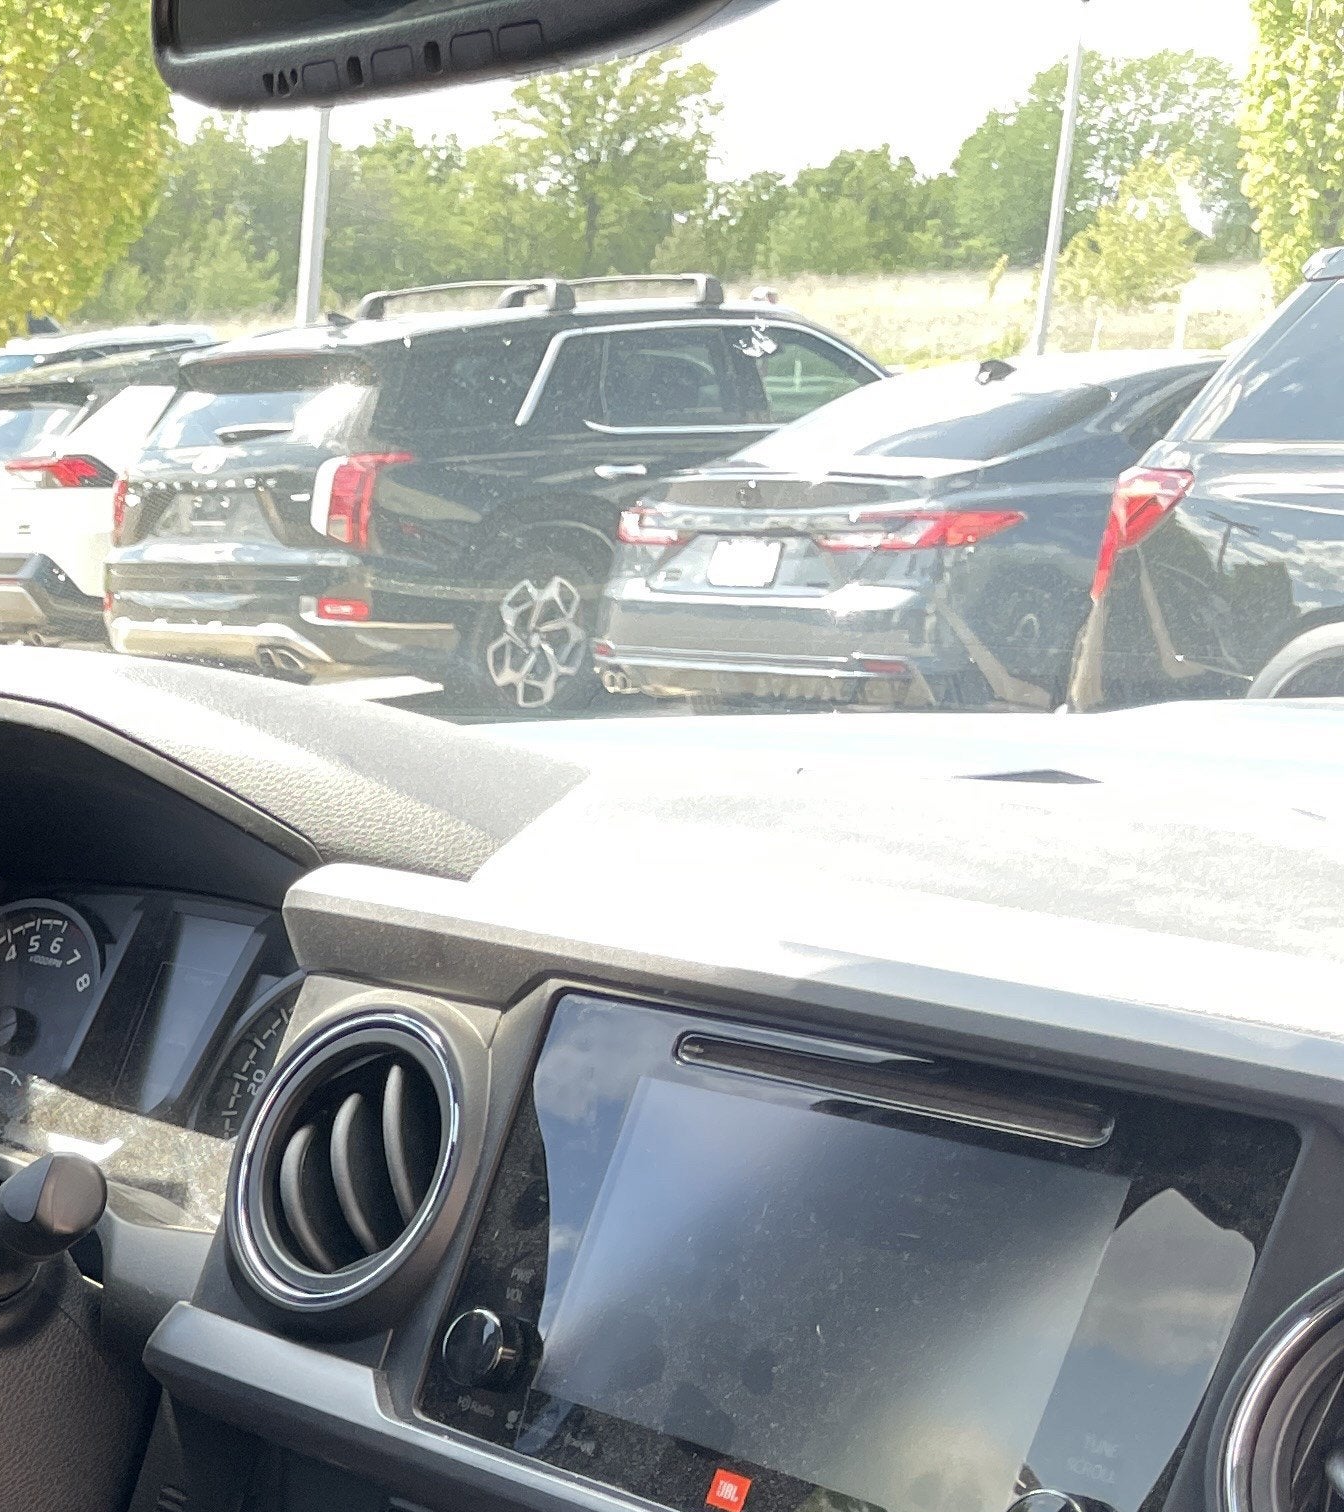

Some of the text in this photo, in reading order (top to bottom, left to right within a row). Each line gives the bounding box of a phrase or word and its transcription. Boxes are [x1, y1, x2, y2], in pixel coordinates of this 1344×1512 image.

[4, 944, 18, 963] 4
[27, 934, 42, 954] 5
[48, 936, 65, 954] 6
[66, 948, 82, 967] 7
[75, 972, 91, 993] 8
[246, 1068, 267, 1097] 20
[715, 1479, 739, 1503] JBL
